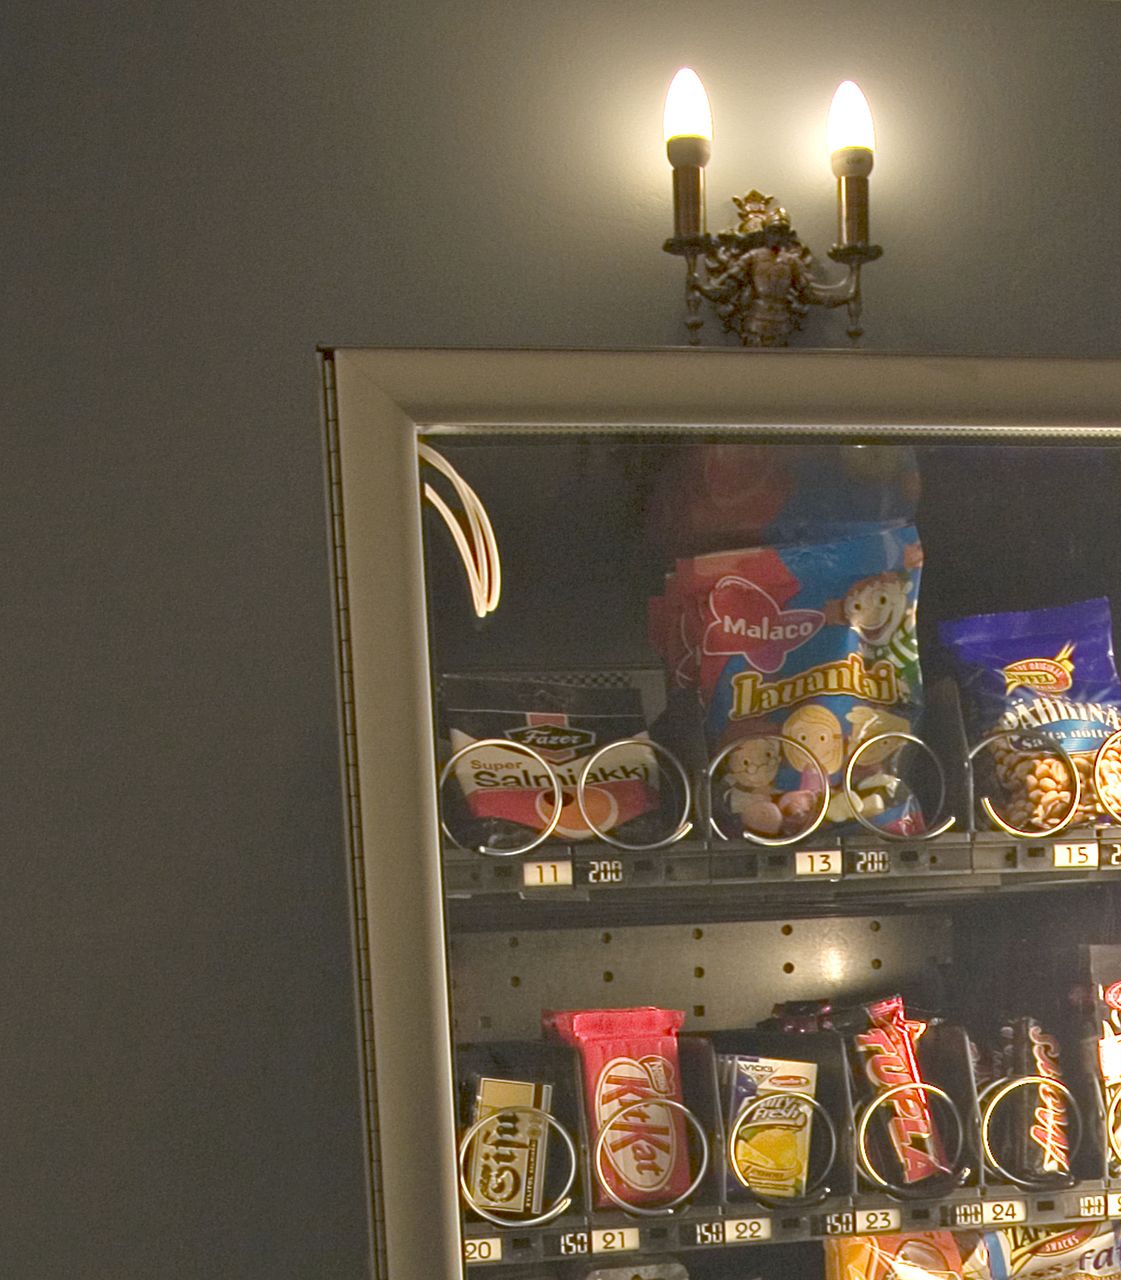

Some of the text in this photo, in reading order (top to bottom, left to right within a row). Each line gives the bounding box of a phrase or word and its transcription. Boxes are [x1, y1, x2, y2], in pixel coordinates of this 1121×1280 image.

[723, 614, 814, 640] Malaco
[732, 655, 897, 719] Lauantai
[519, 729, 582, 746] Fazer
[469, 758, 523, 771] Super
[472, 763, 650, 790] Salmiakki
[807, 854, 833, 873] 13
[856, 851, 890, 874] 200
[1065, 846, 1089, 865] 15
[535, 864, 559, 884] 11
[588, 860, 623, 883] 200
[956, 1203, 982, 1224] 100
[991, 1203, 1017, 1221] 24
[1079, 1195, 1105, 1217] 100
[734, 1221, 762, 1240] 22
[826, 1212, 853, 1234] 150
[865, 1212, 892, 1230] 23
[602, 1231, 626, 1250] 21
[695, 1222, 723, 1245] 150
[465, 1240, 491, 1260] 20
[560, 1233, 588, 1255] 150
